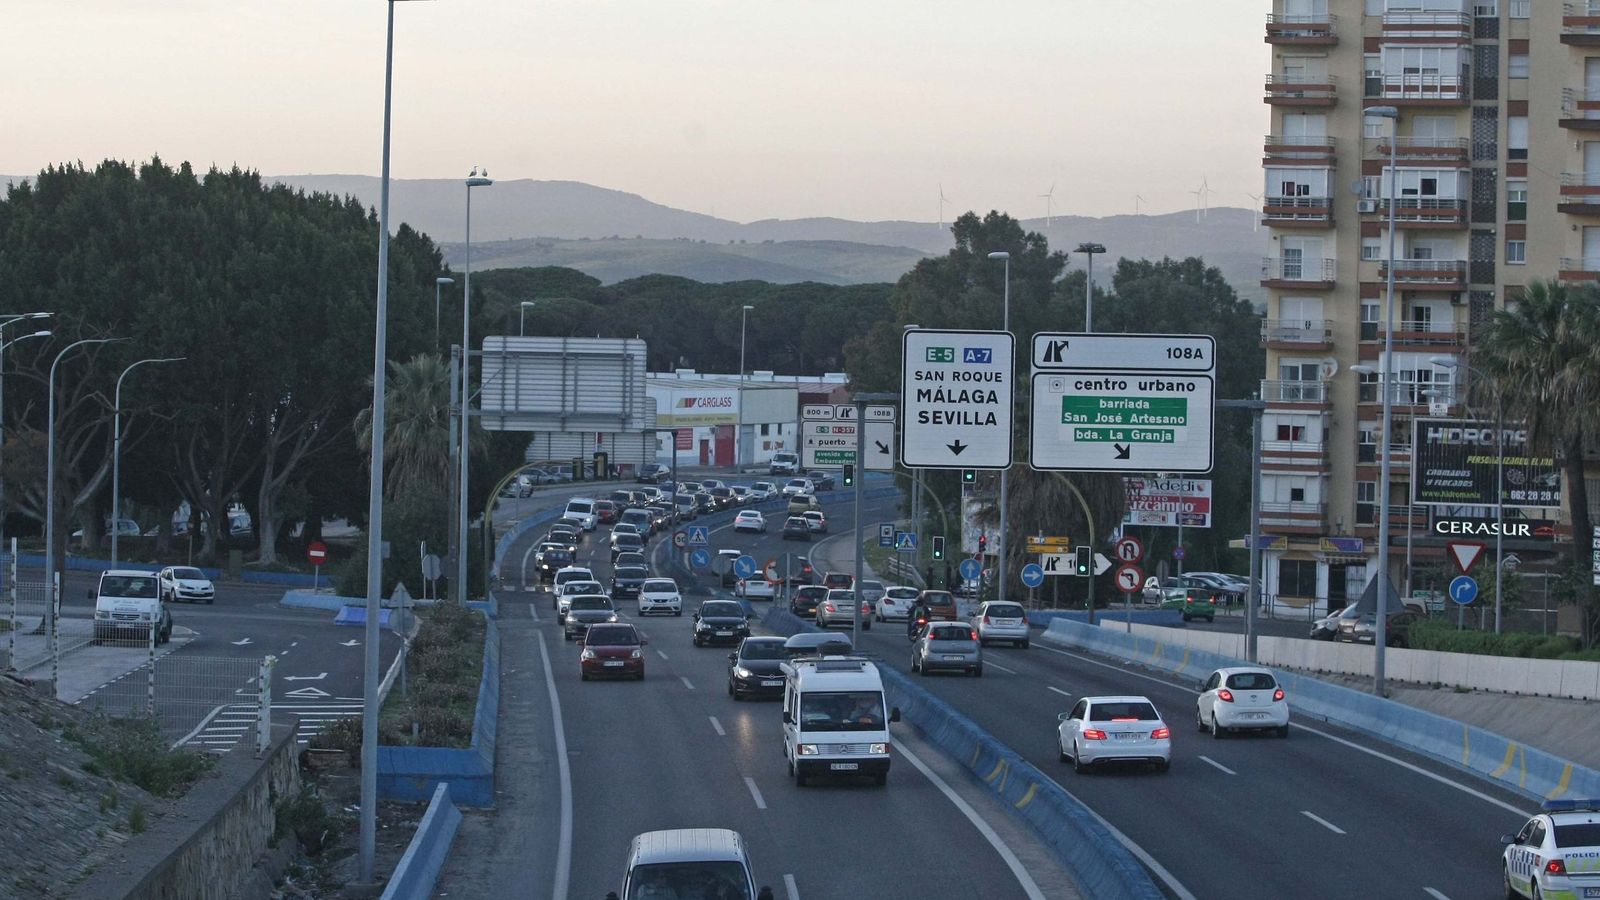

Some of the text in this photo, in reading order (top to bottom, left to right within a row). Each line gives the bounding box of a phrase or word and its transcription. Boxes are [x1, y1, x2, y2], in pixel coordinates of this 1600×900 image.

[927, 349, 991, 362] E-5 A-7
[1166, 347, 1204, 360] 108A
[914, 370, 1003, 383] SAN ROQUE
[1074, 378, 1197, 392] centro urbano
[916, 385, 999, 404] MÁLAGA
[697, 397, 732, 408] CARGLASS
[1099, 399, 1150, 409] barriada
[917, 410, 997, 426] SEVILLA
[1064, 412, 1185, 424] San José Artesano
[1075, 429, 1172, 442] bda. La Granja
[818, 439, 846, 447] puerto
[1152, 480, 1195, 491] Adedi
[1511, 490, 1526, 500] 662
[1527, 491, 1538, 500] 28
[1540, 491, 1552, 501] 28
[1436, 520, 1531, 536] CERASUR
